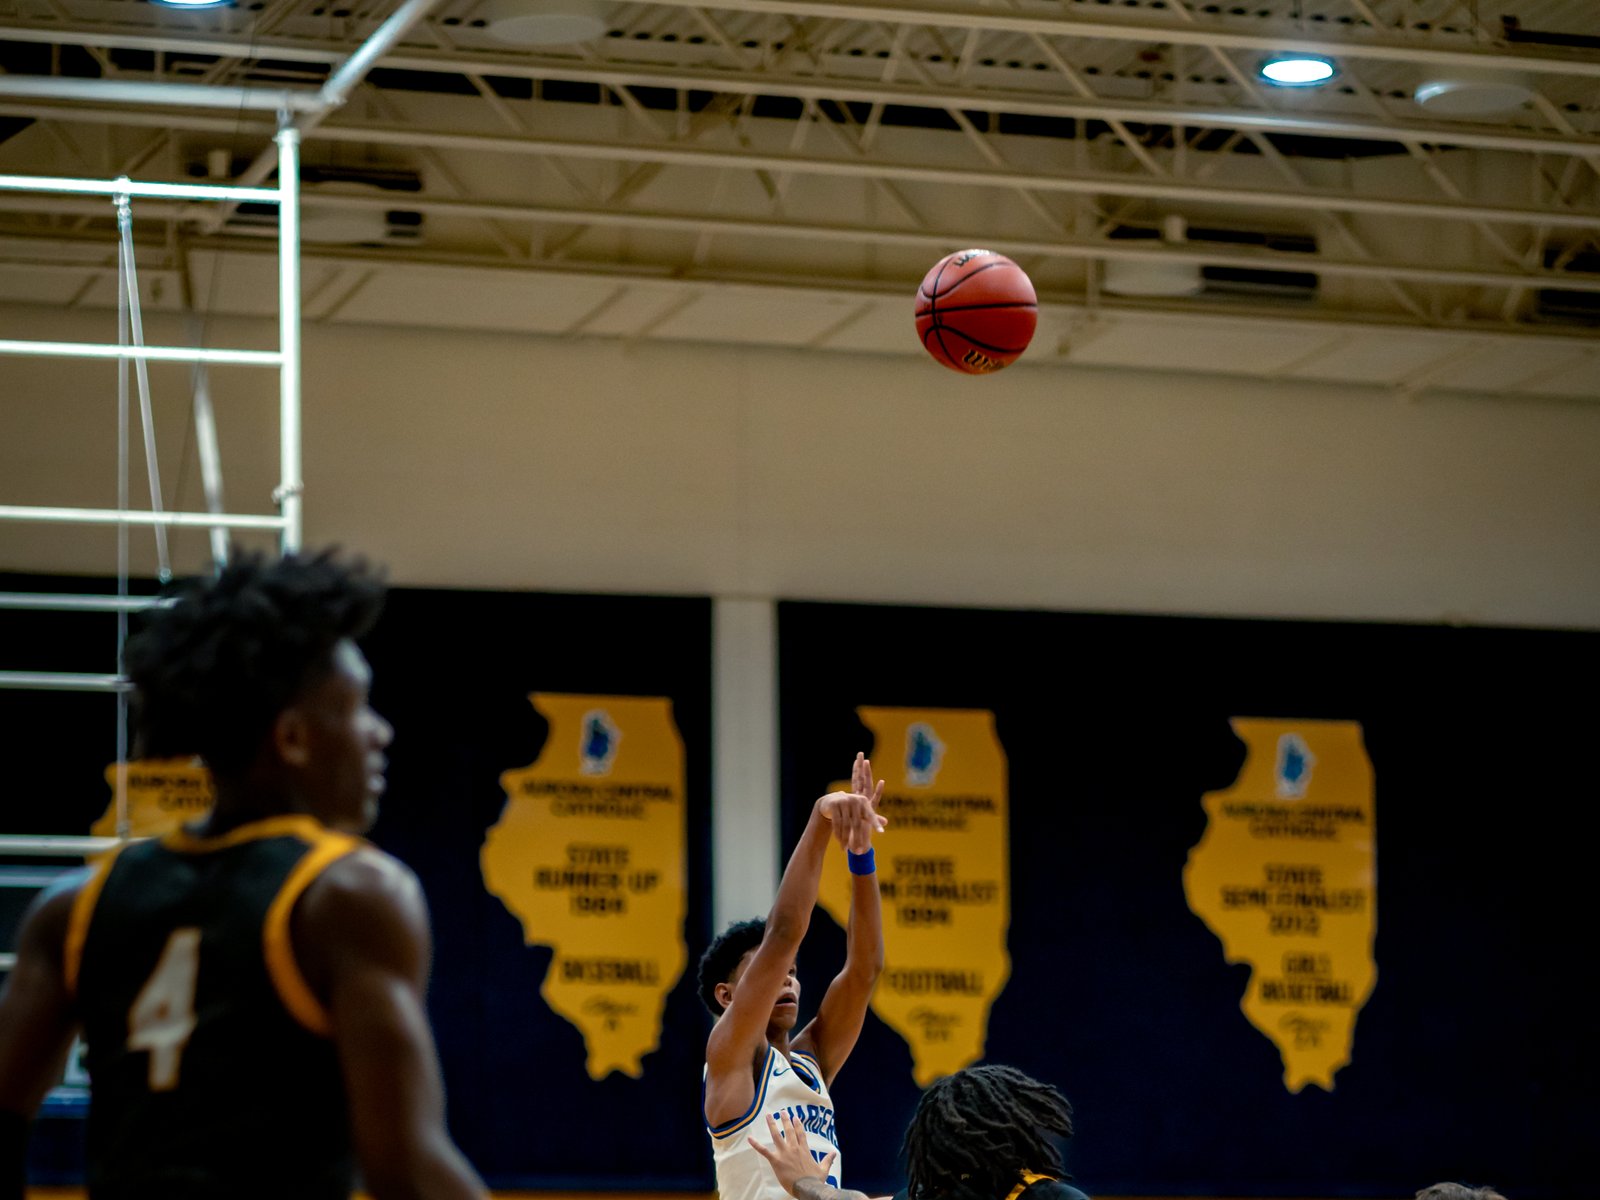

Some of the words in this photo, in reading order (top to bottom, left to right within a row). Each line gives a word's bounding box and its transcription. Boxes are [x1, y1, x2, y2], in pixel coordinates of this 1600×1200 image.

[566, 843, 632, 868] STATE
[892, 856, 957, 880] STATE
[1262, 864, 1327, 888] STATE
[560, 956, 661, 985] BASEBALL
[886, 967, 985, 995] FOOTBALL
[1259, 979, 1355, 1005] BASKETBALL
[127, 926, 202, 1091] 4
